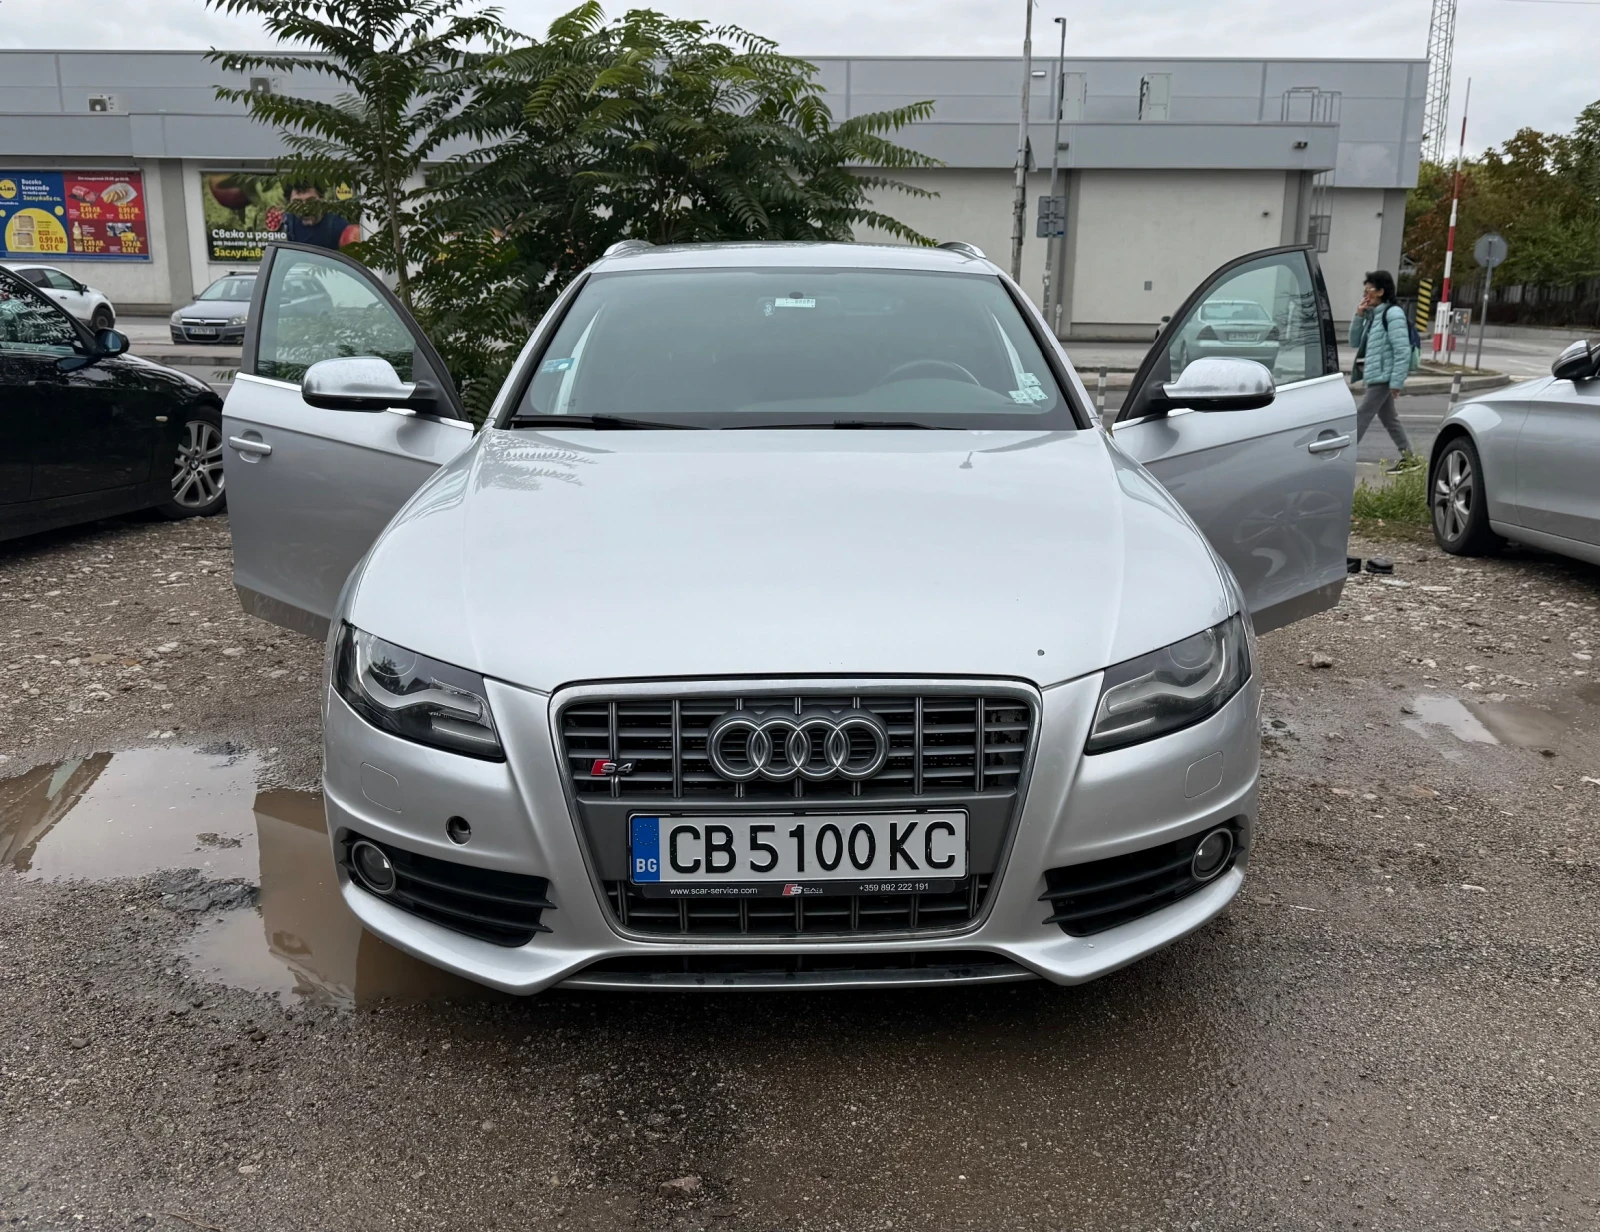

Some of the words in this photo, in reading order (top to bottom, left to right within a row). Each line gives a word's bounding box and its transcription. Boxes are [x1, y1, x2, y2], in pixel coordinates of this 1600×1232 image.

[212, 229, 245, 239] Свежо
[255, 231, 287, 241] родно
[601, 763, 633, 773] S4
[669, 824, 736, 874] CB
[749, 822, 876, 872] 5100
[889, 821, 956, 870] KC
[636, 858, 657, 873] BG
[669, 887, 758, 895] www.scar-service.com
[859, 884, 878, 892] +359
[897, 883, 913, 891] 222
